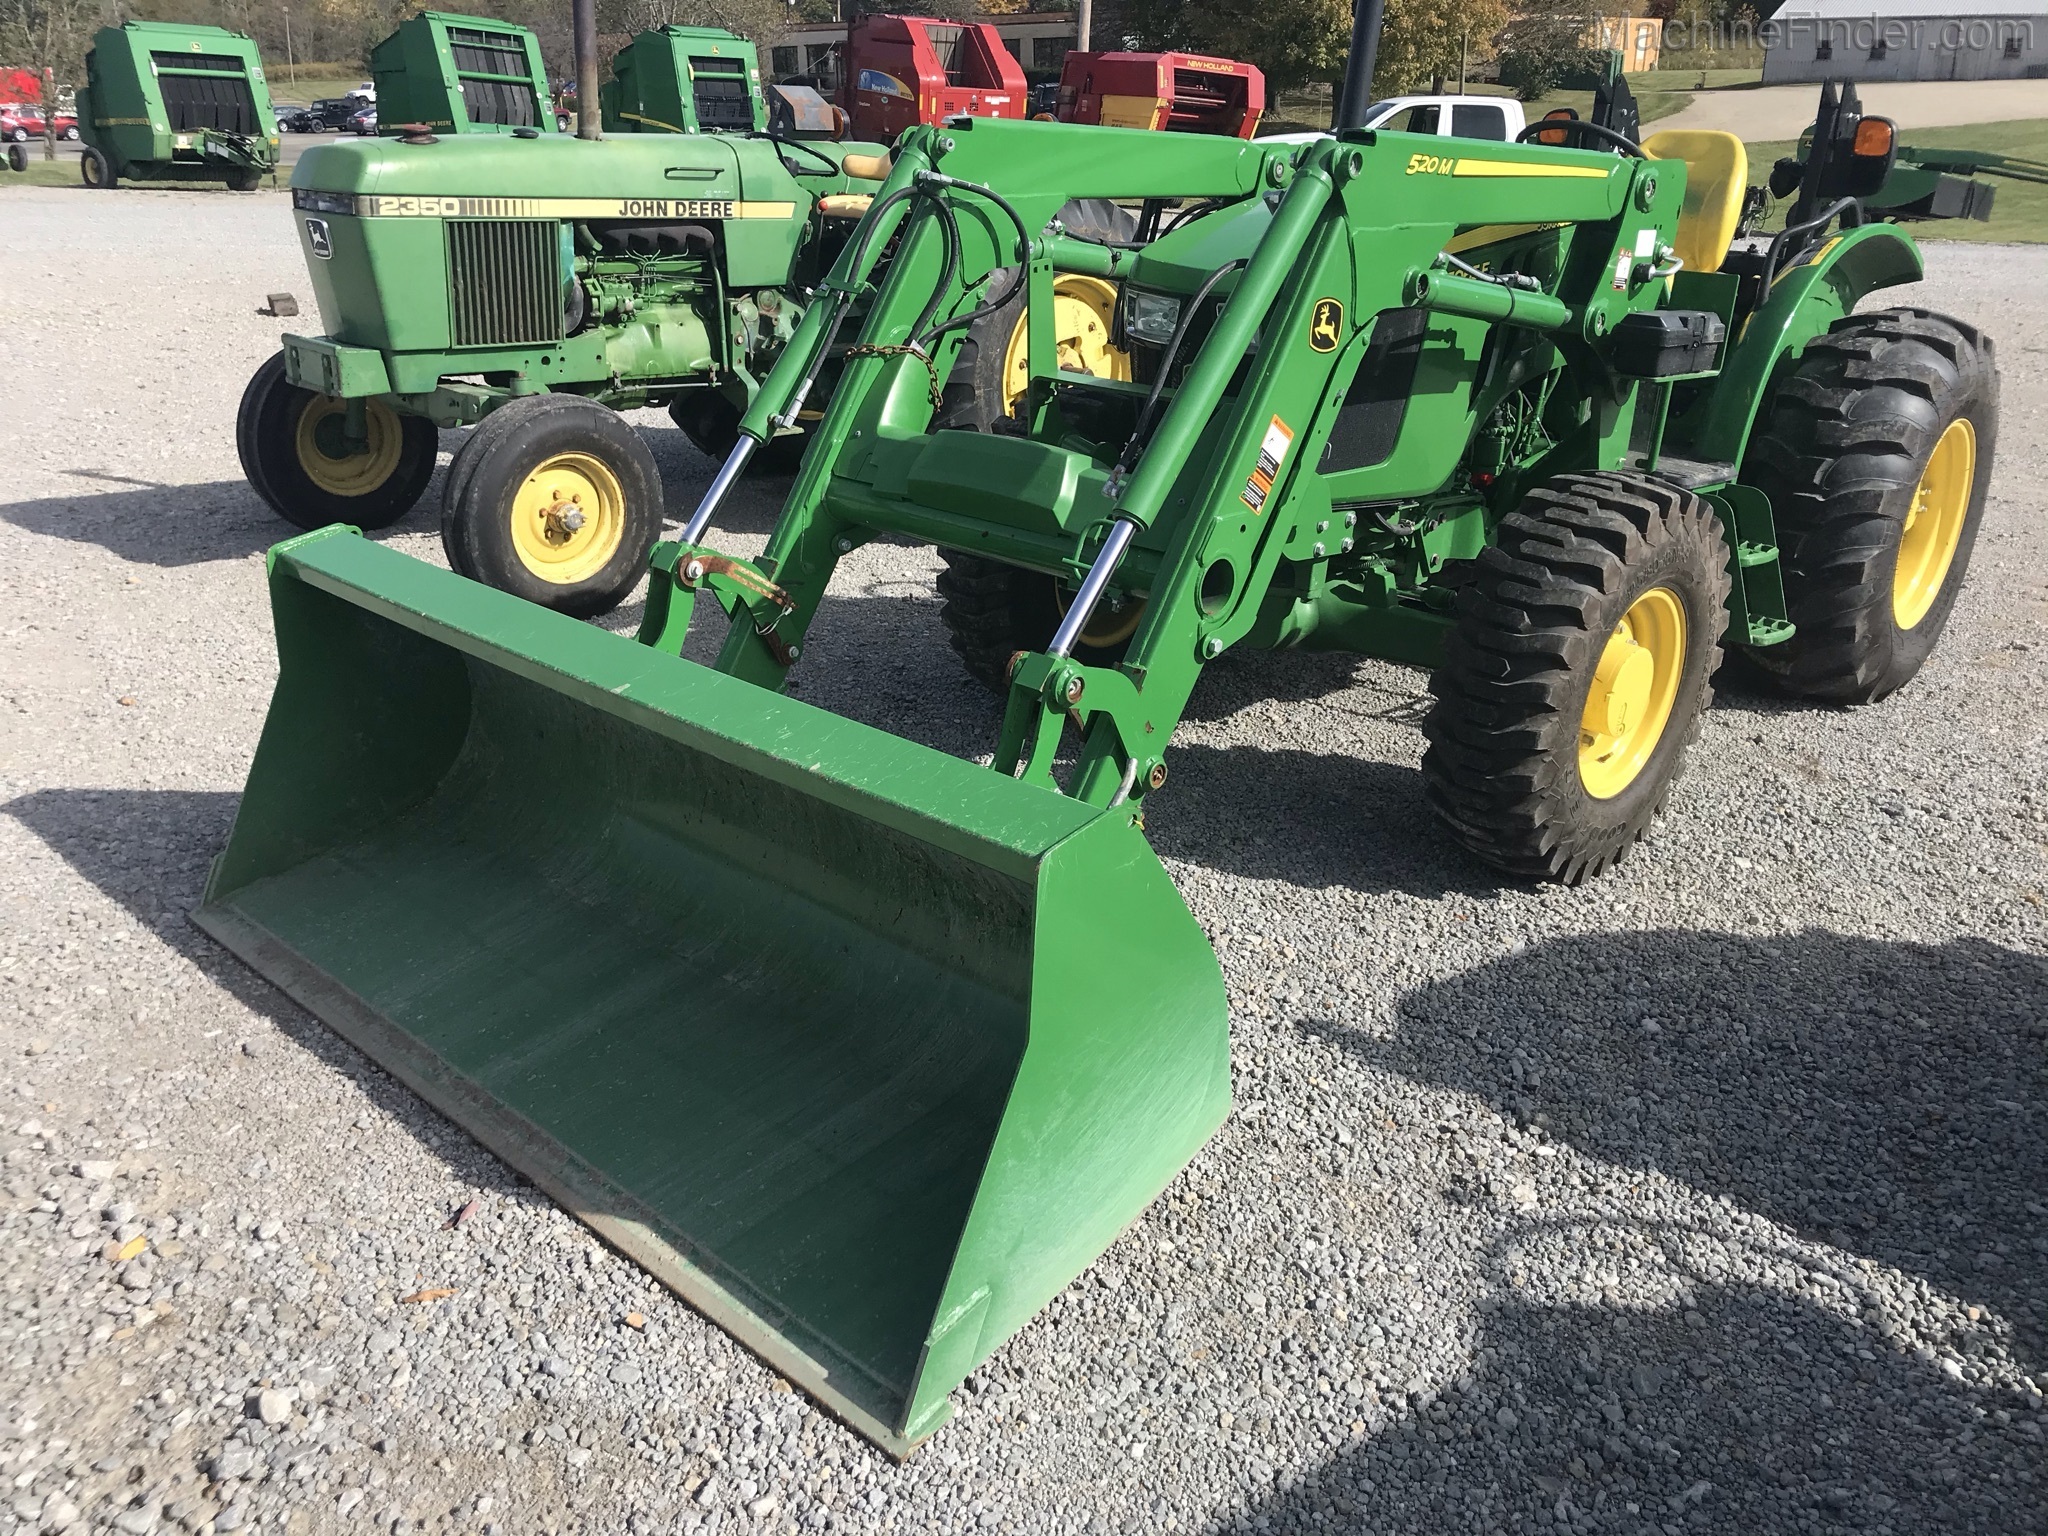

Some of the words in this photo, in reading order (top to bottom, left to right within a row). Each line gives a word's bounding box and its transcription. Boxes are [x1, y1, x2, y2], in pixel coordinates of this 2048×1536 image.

[1187, 60, 1203, 68] NEW
[1203, 62, 1234, 72] HOLLAND
[378, 196, 460, 216] 2350
[618, 200, 668, 217] JOHN
[675, 201, 733, 217] DEERE
